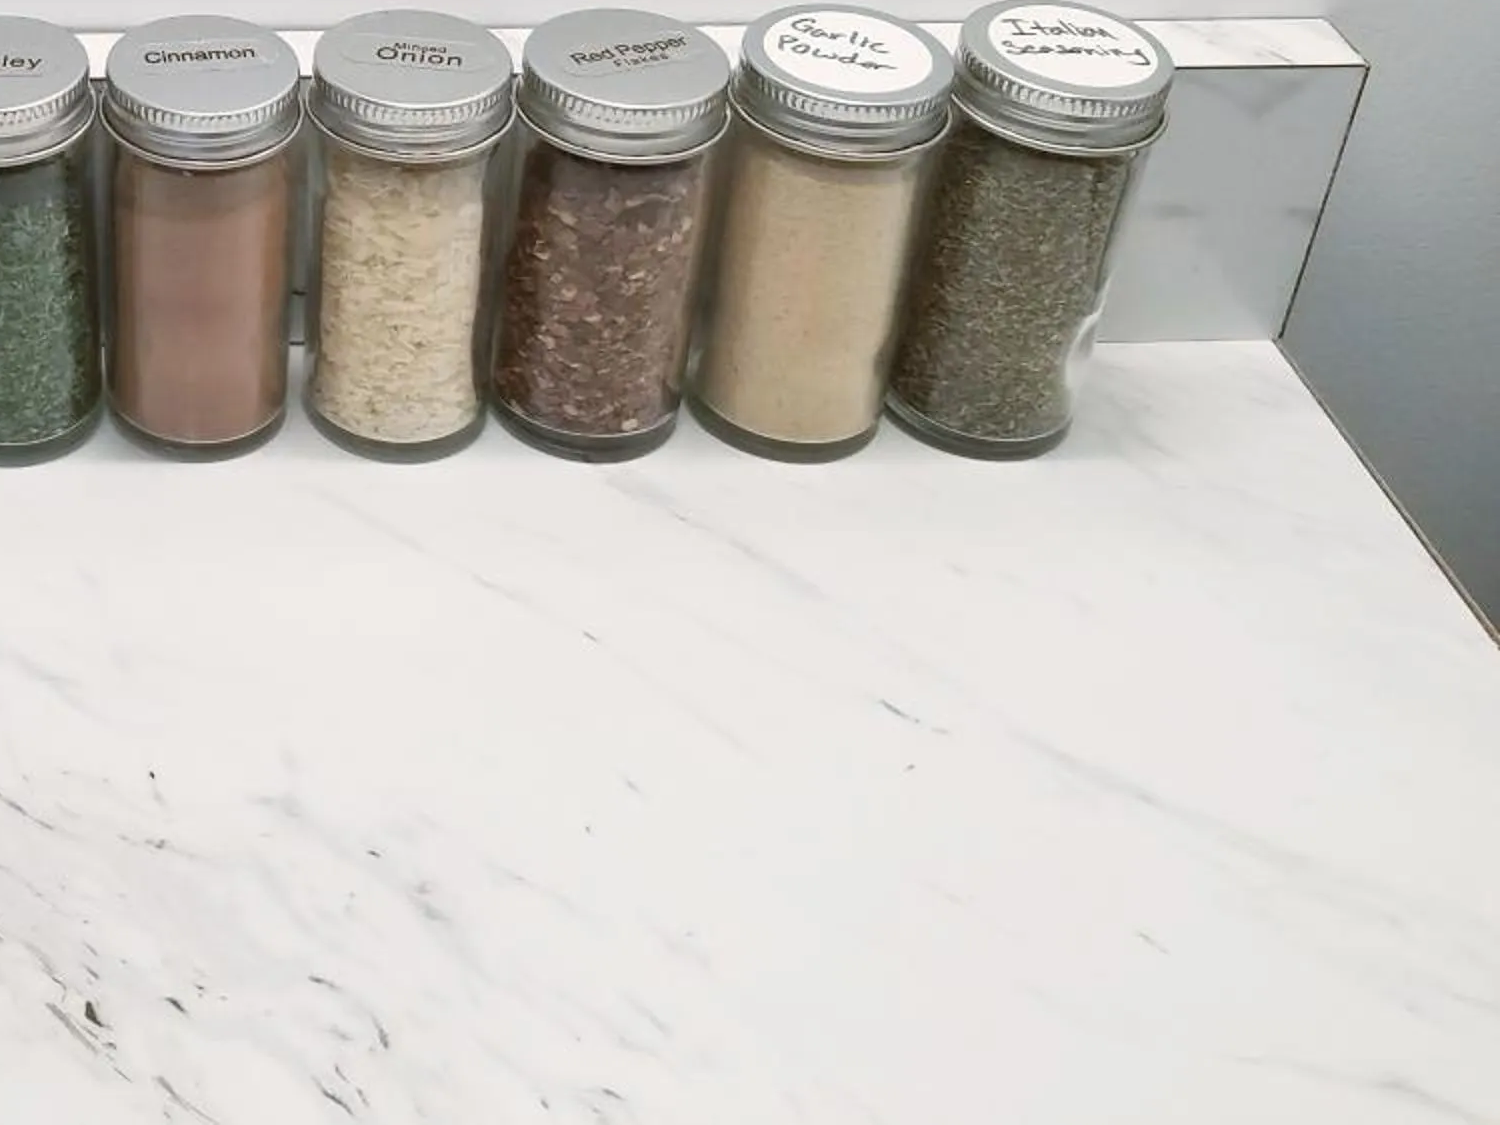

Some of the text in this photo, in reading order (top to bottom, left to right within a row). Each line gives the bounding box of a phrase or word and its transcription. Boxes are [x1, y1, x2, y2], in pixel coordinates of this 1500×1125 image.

[791, 17, 890, 54] Garlic
[1001, 18, 1119, 41] Italian
[143, 48, 256, 64] Cinnamon
[376, 46, 462, 67] Onion
[569, 36, 687, 65] Red Pepper
[613, 54, 669, 67] Flakes
